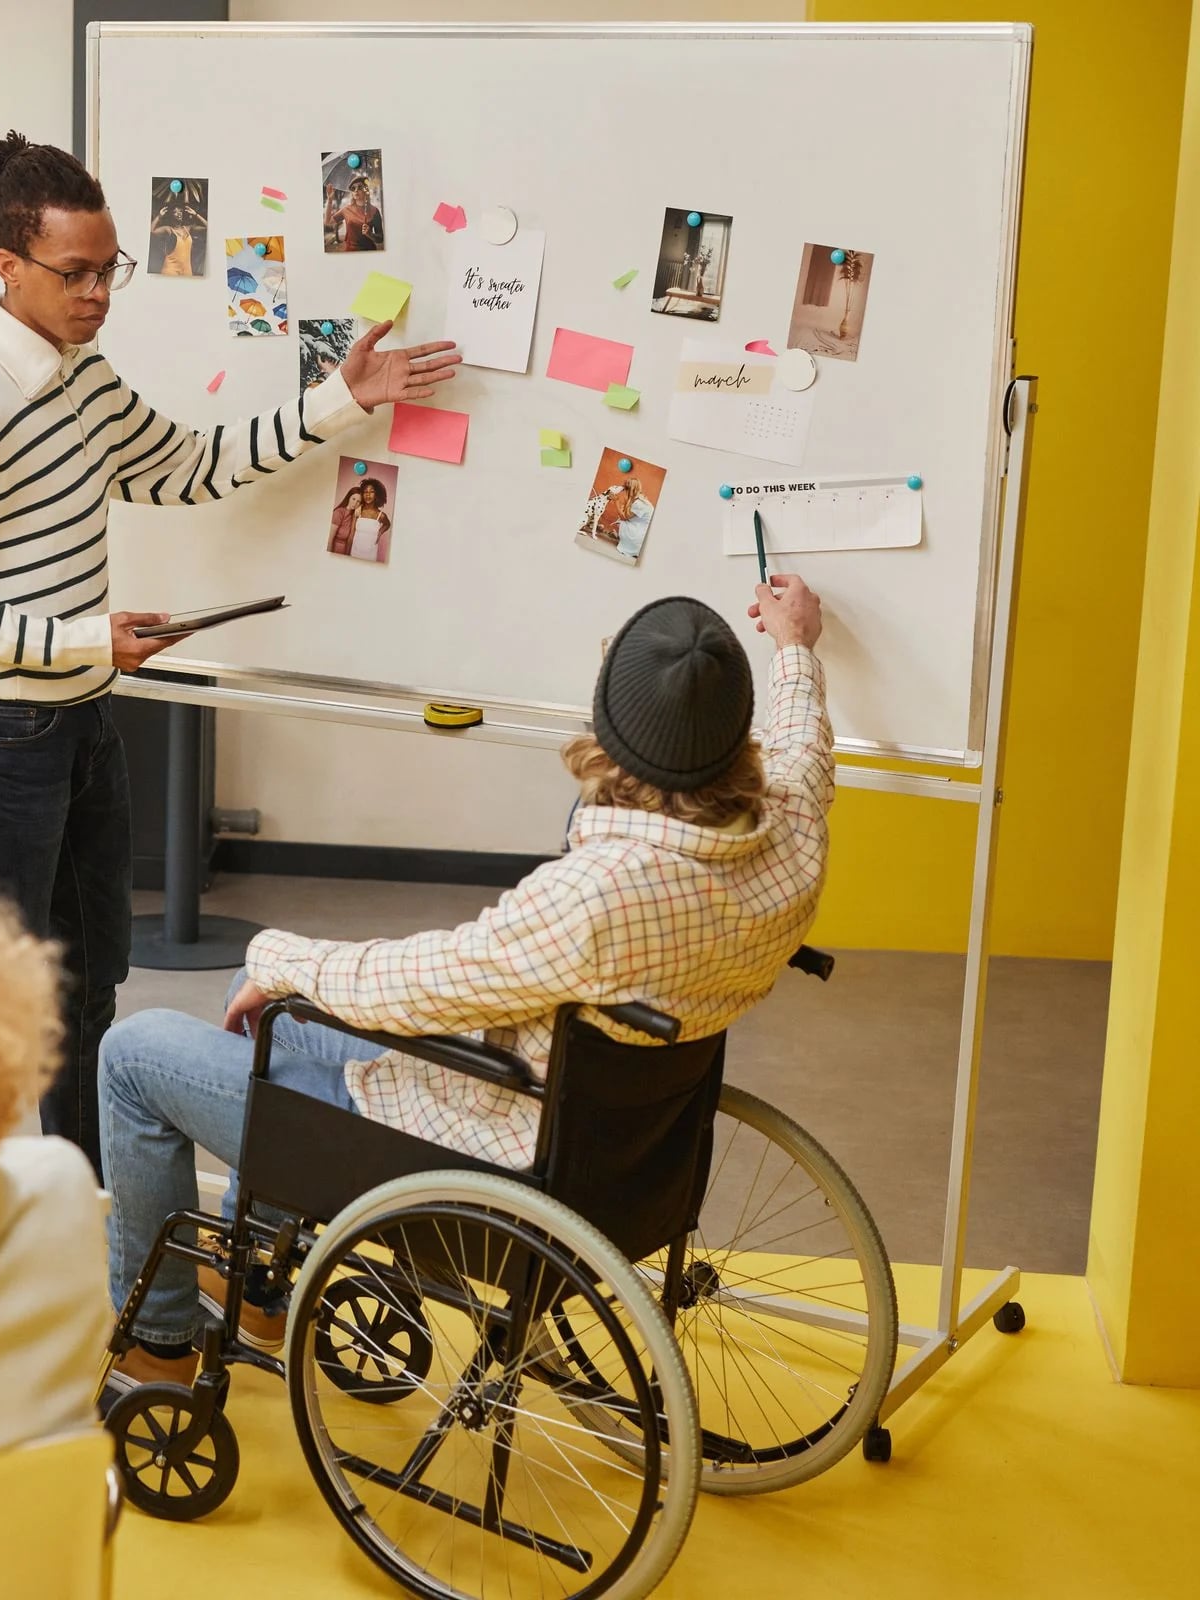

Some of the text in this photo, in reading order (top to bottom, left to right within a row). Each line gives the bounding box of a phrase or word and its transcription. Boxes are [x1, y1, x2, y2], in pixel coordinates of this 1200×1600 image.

[463, 267, 525, 294] It's sweater
[473, 294, 511, 311] weather
[694, 364, 750, 388] march
[730, 482, 816, 495] TO DO THIS WEEK
